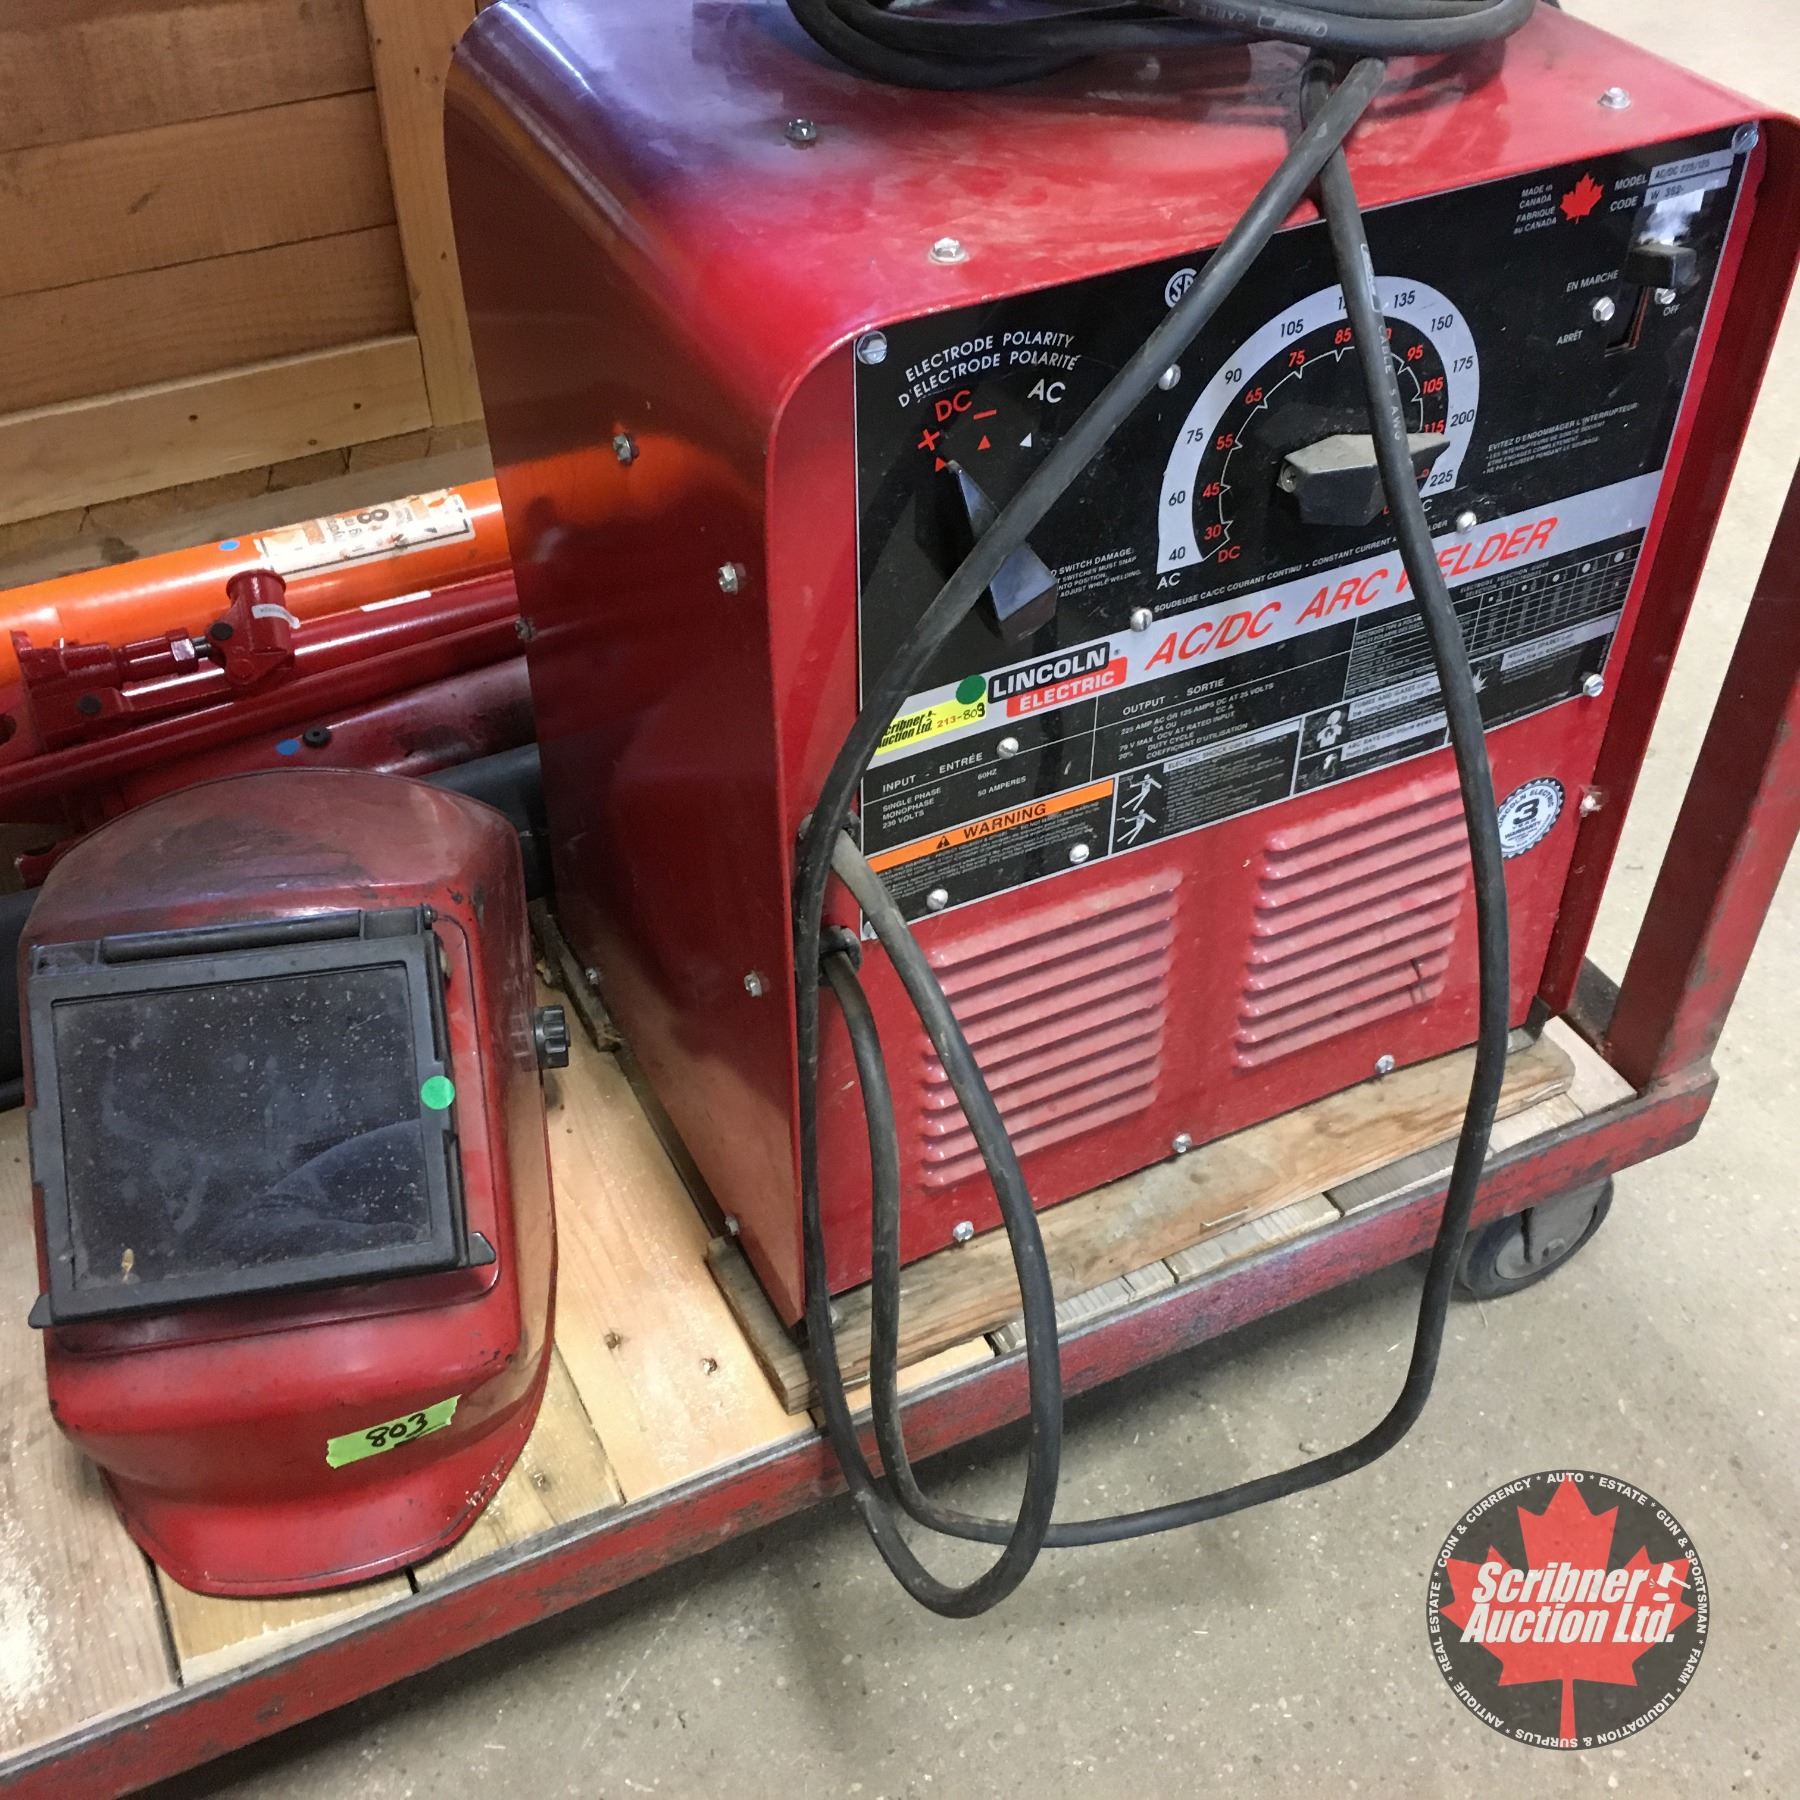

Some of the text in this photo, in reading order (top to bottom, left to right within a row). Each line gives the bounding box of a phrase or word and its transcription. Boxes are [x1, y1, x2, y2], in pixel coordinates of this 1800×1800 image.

[1521, 184, 1544, 197] MADE
[1614, 174, 1647, 191] MODEL
[1519, 194, 1552, 209] CANADA
[1609, 195, 1639, 212] CODE
[1524, 216, 1557, 232] CANADA
[1566, 270, 1619, 292] EN MARCHE
[1393, 290, 1416, 309] 135
[1663, 304, 1680, 317] OFF
[1280, 319, 1304, 337] 105
[1430, 314, 1454, 332] 150
[1334, 328, 1352, 345] 85
[905, 330, 1075, 383] ELECTRODE POLARITY
[1289, 350, 1306, 367] 75
[1407, 345, 1424, 361] 95
[1452, 355, 1474, 374] 175
[898, 350, 1082, 408] D'ELECTRODE POLARITÉ
[1225, 368, 1243, 384] 90
[1422, 376, 1445, 394] 105
[1027, 378, 1066, 404] AC
[1244, 387, 1264, 406] 65
[934, 389, 973, 422] DC
[1450, 409, 1476, 428] 200
[1187, 429, 1204, 444] 75
[1216, 433, 1234, 449] 55
[1429, 470, 1454, 487] 225
[1168, 491, 1186, 506] 60
[1202, 482, 1221, 498] 45
[1204, 525, 1222, 540] 30
[1168, 546, 1186, 561] 40
[1217, 546, 1241, 564] DC
[1059, 560, 1093, 575] SWITCH
[1062, 568, 1097, 583] SWITCHES
[1154, 538, 1391, 613] SOUDEUSE CA/CC COURANT CONTINU CONSTANT CURRENT
[1156, 572, 1182, 591] AC
[1144, 601, 1282, 671] AC/DC
[1295, 568, 1389, 625] ARC
[1396, 518, 1558, 593] ELDER
[992, 646, 1107, 698] LINCOLN
[1019, 670, 1115, 713] ELECTRIC
[1122, 677, 1226, 716] OUTPUT SORTIE
[1134, 720, 1153, 731] AMP
[1153, 716, 1165, 726] AC
[1166, 712, 1178, 722] OR
[1193, 701, 1216, 714] AMPS
[1216, 698, 1228, 707] DC
[1228, 693, 1240, 703] AT
[1249, 682, 1275, 695] VOLTS
[884, 711, 930, 737] cribner
[1130, 741, 1136, 749] V
[1136, 736, 1154, 747] MAX
[1175, 727, 1185, 736] AT
[1185, 720, 1212, 732] RATED
[1213, 710, 1236, 724] INPUT
[1152, 725, 1164, 734] CA
[1165, 721, 1177, 730] OU
[1215, 706, 1227, 715] CC
[878, 719, 933, 749] uction Ltd.
[1147, 740, 1168, 752] DUTY
[1169, 732, 1195, 744] CYCLE
[1146, 739, 1196, 760] COEFFICIENT
[882, 752, 984, 793] INPUT ENTRÉE
[882, 787, 942, 813] SINGLE PHASE
[977, 788, 988, 798] 50
[882, 798, 935, 821] MONOPHASE
[898, 810, 925, 826] VOLTS
[1512, 798, 1540, 825] 3
[963, 803, 1048, 840] WARNING
[365, 1412, 429, 1448] 803
